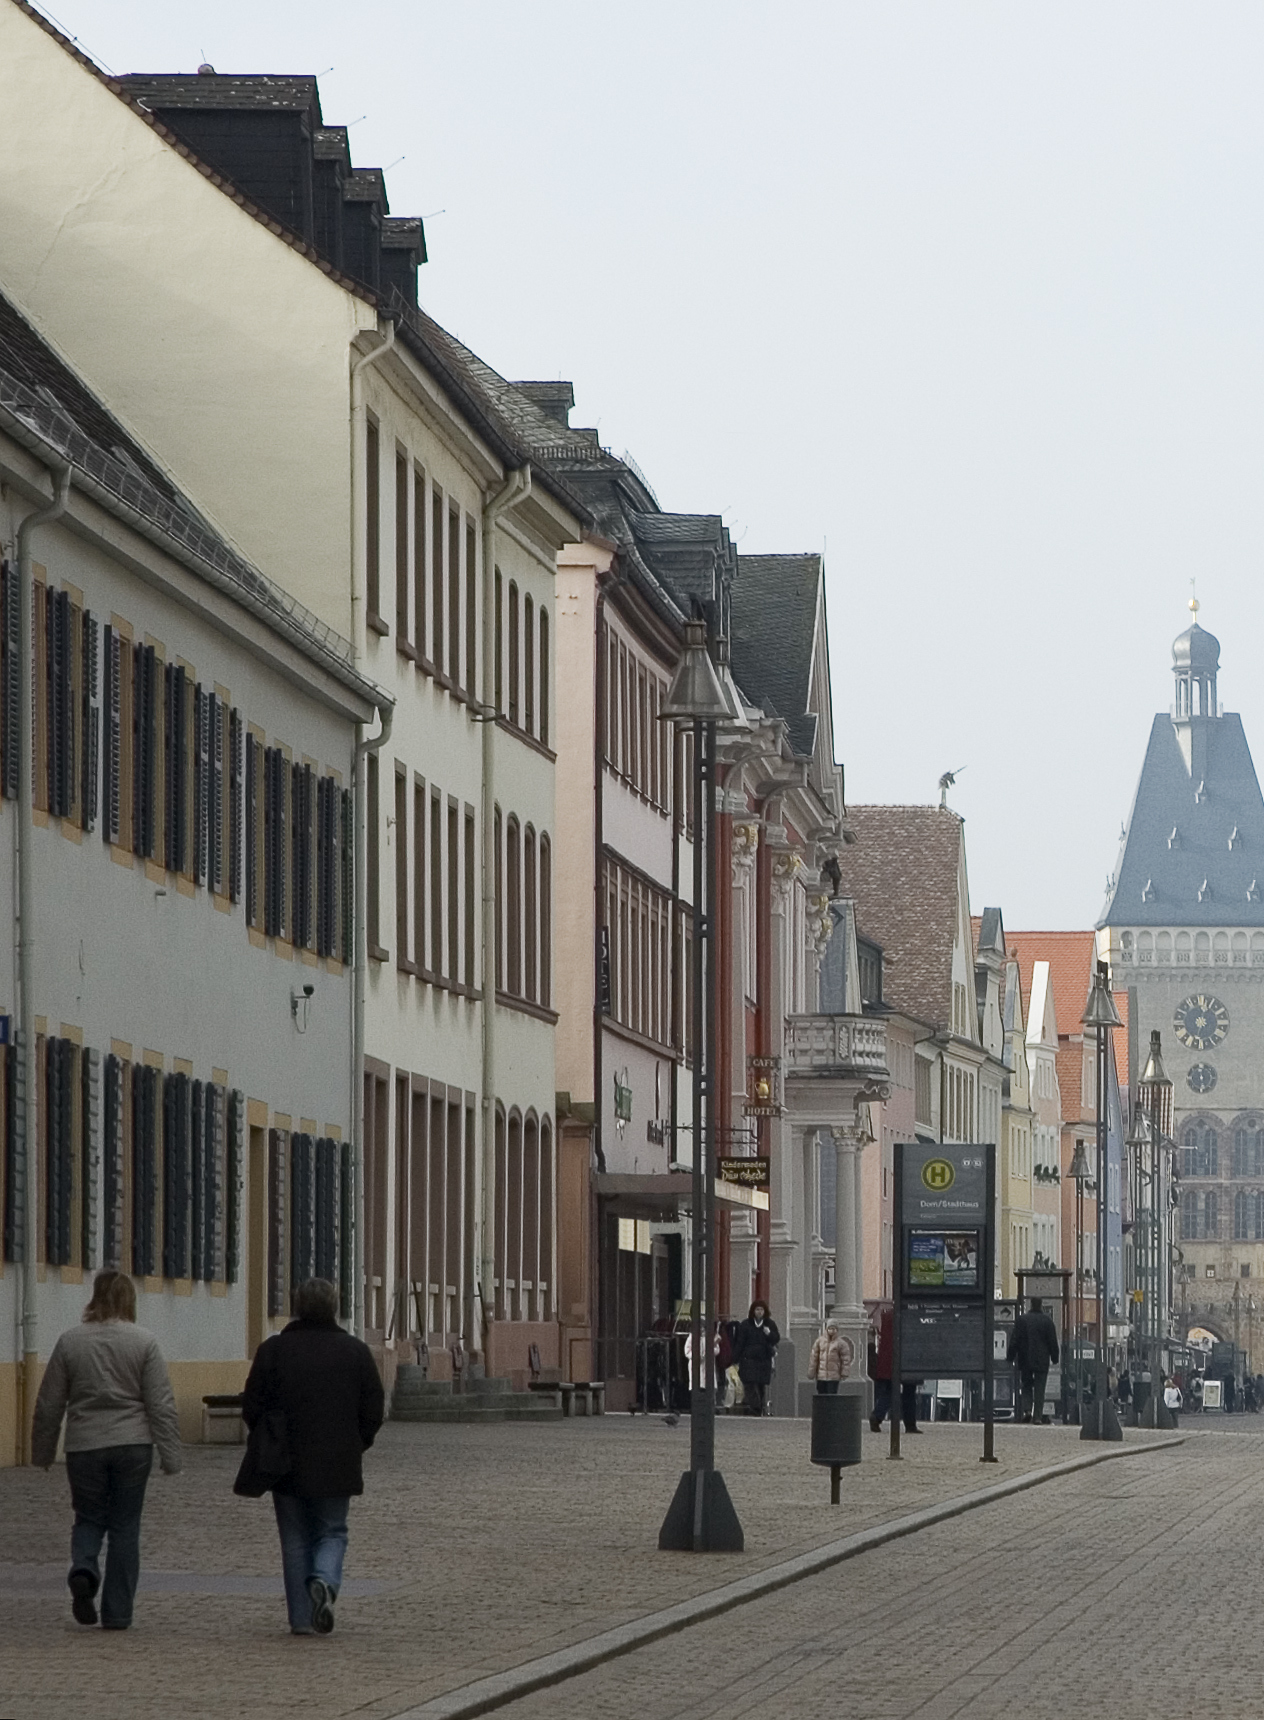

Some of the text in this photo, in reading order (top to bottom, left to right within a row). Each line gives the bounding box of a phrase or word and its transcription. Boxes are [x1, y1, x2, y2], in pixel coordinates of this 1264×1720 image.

[746, 1106, 779, 1116] HOTEL
[930, 1165, 946, 1183] H
[920, 1200, 979, 1208] Dom/Stadthaus
